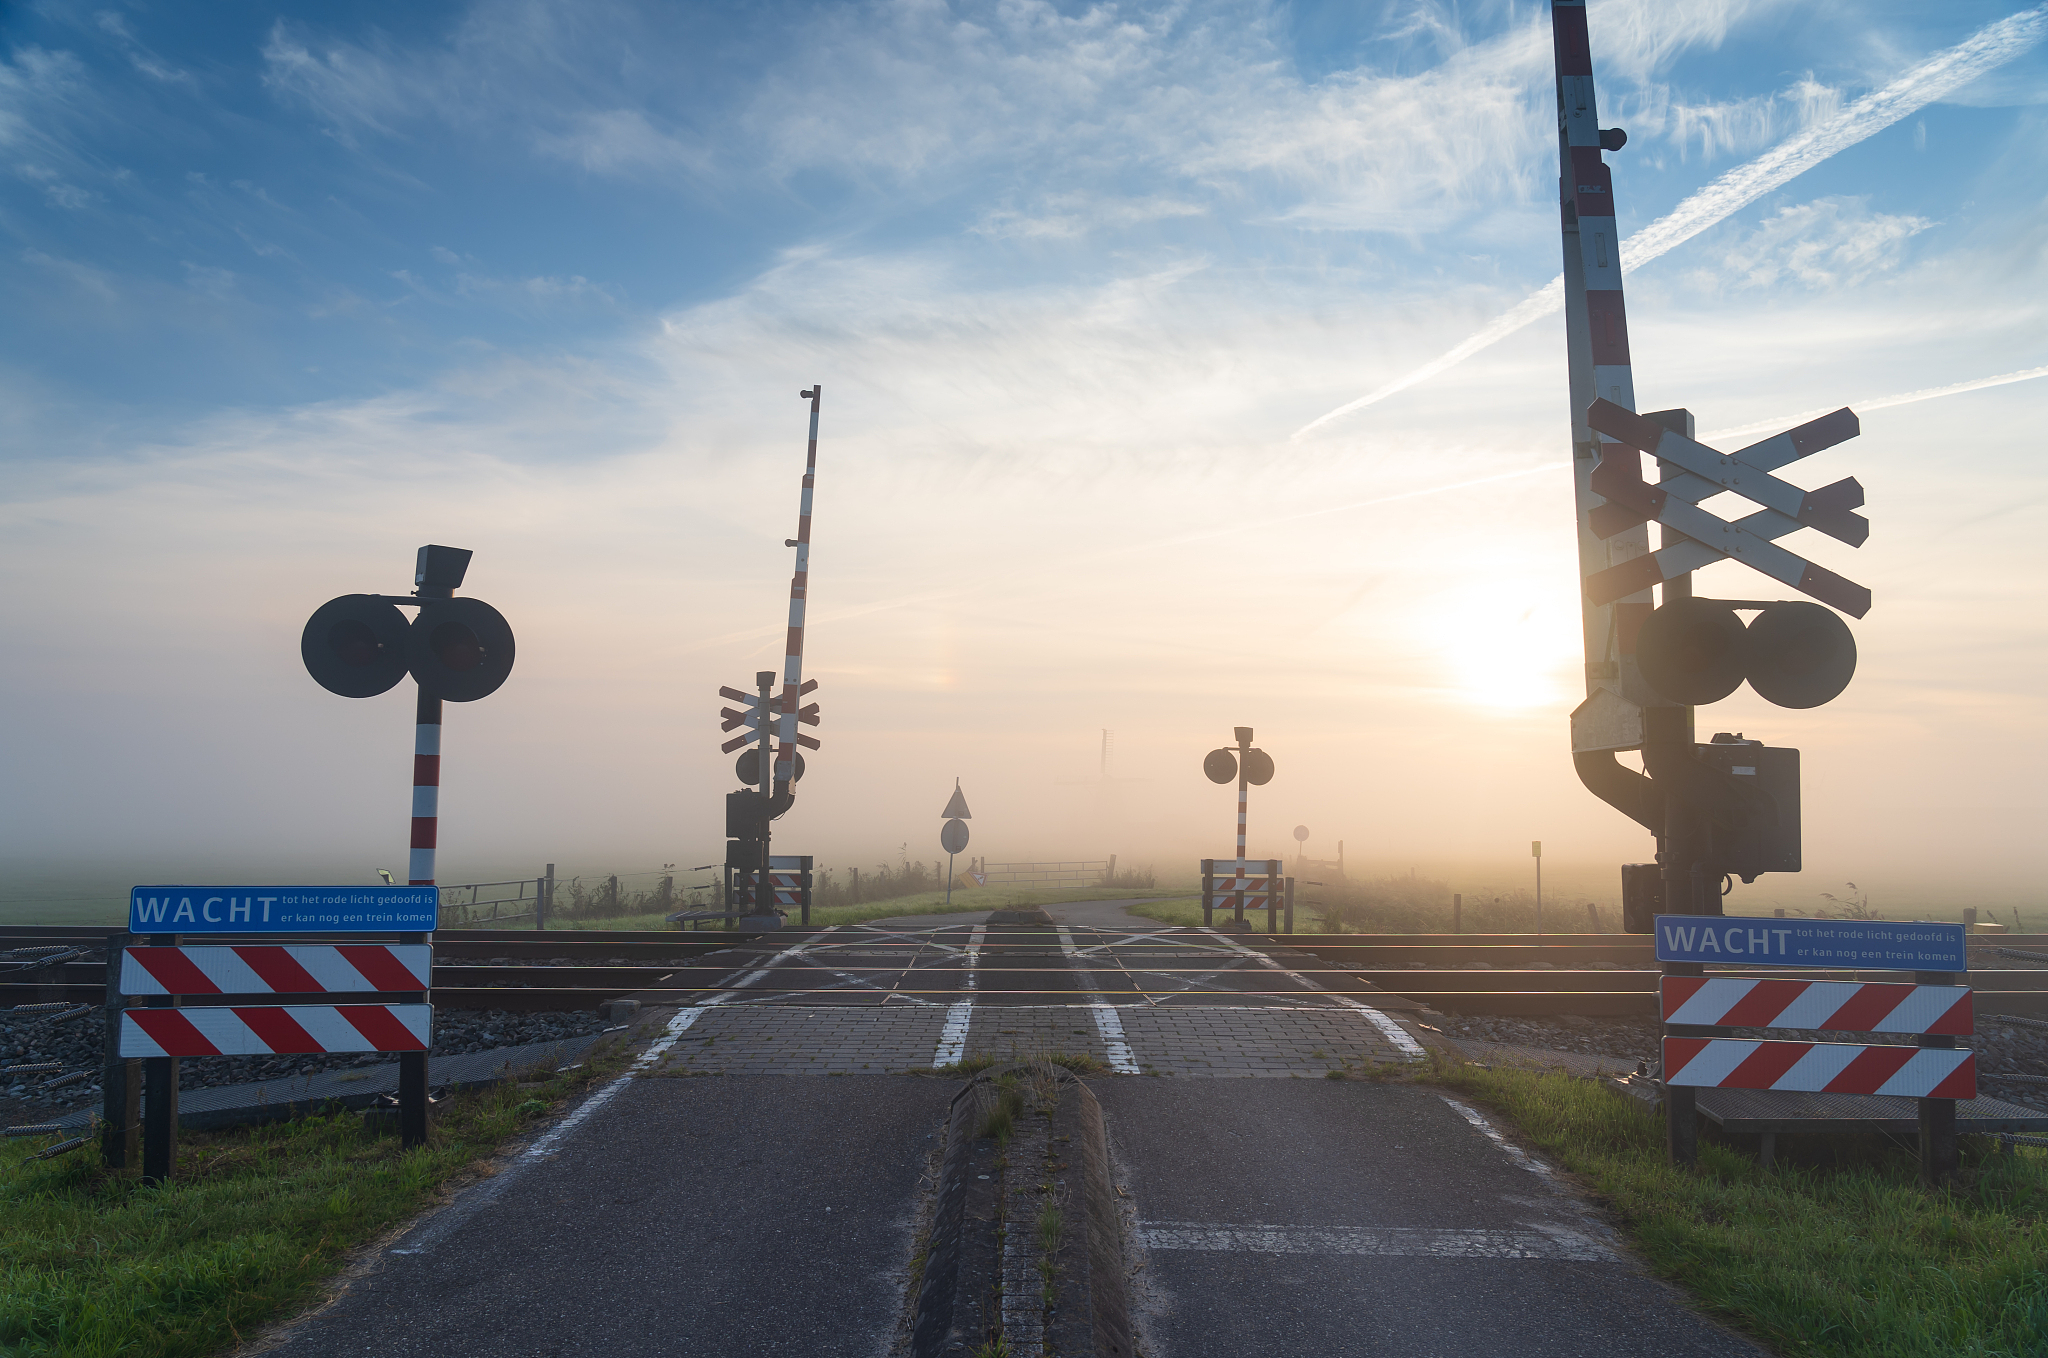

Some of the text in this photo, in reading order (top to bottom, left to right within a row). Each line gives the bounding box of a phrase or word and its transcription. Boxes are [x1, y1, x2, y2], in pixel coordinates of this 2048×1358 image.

[282, 894, 433, 906] tot het rode licht gedoofd is
[135, 896, 278, 923] WACHT
[295, 913, 315, 922] kan
[319, 914, 340, 925] nog
[343, 914, 363, 922] een
[365, 913, 393, 922] trein
[396, 912, 433, 922] komen
[1663, 925, 1792, 955] WACHT
[1797, 928, 1956, 943] tot het rode licht gedoofd is
[1811, 947, 1832, 957] kan
[1836, 950, 1857, 960] nog
[1862, 951, 1882, 959] een
[1884, 951, 1914, 960] trein
[1917, 951, 1956, 961] komen
